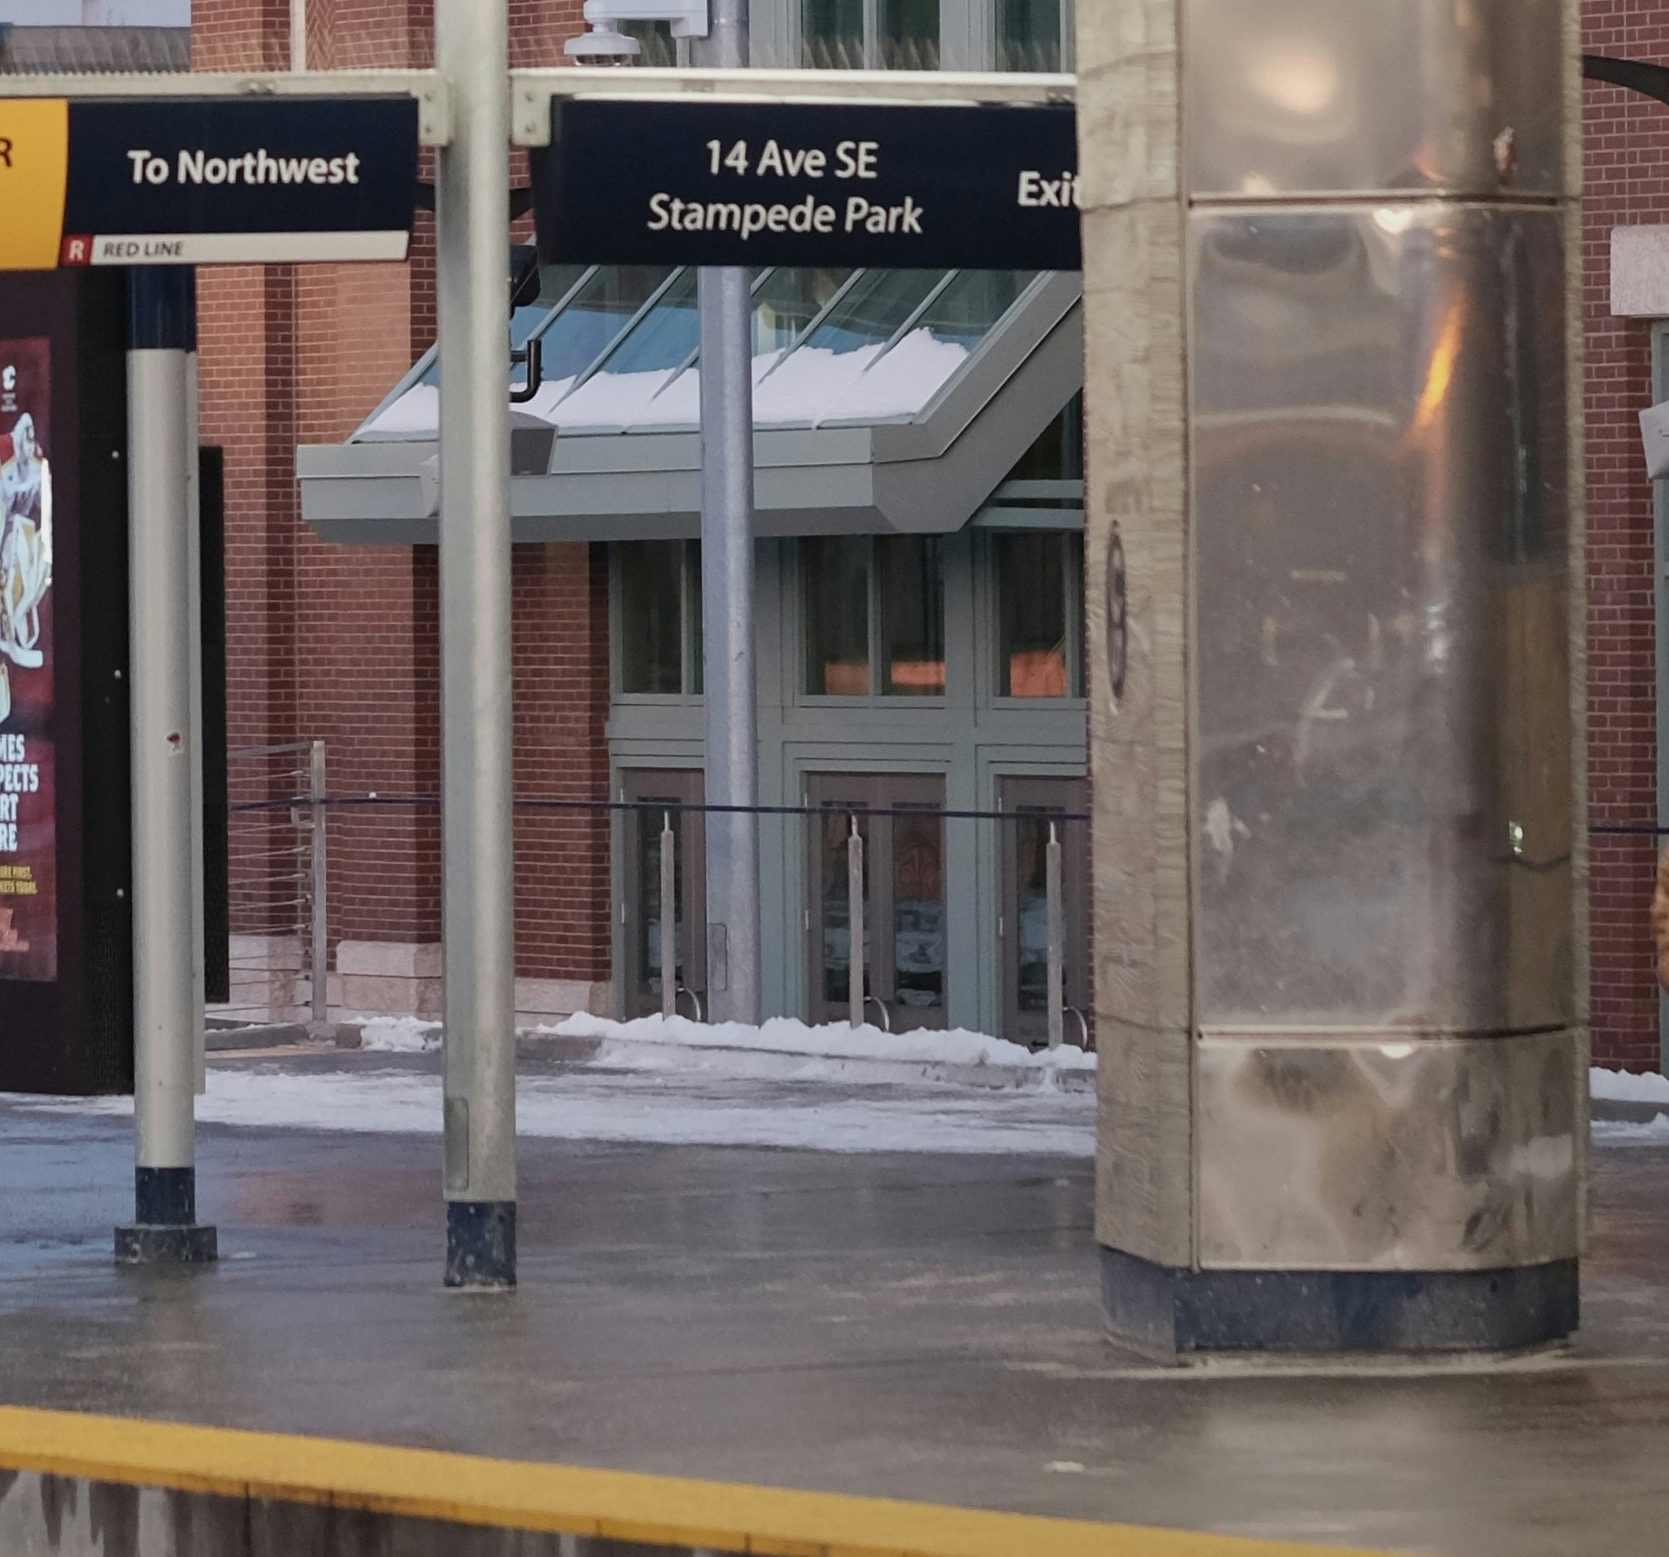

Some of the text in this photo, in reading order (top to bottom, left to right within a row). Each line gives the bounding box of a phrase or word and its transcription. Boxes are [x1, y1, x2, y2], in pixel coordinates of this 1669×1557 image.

[127, 148, 360, 184] To Northwest
[706, 139, 879, 179] 14 Ave SE
[647, 192, 924, 240] Stampede Park
[69, 239, 183, 261] R RED LINE
